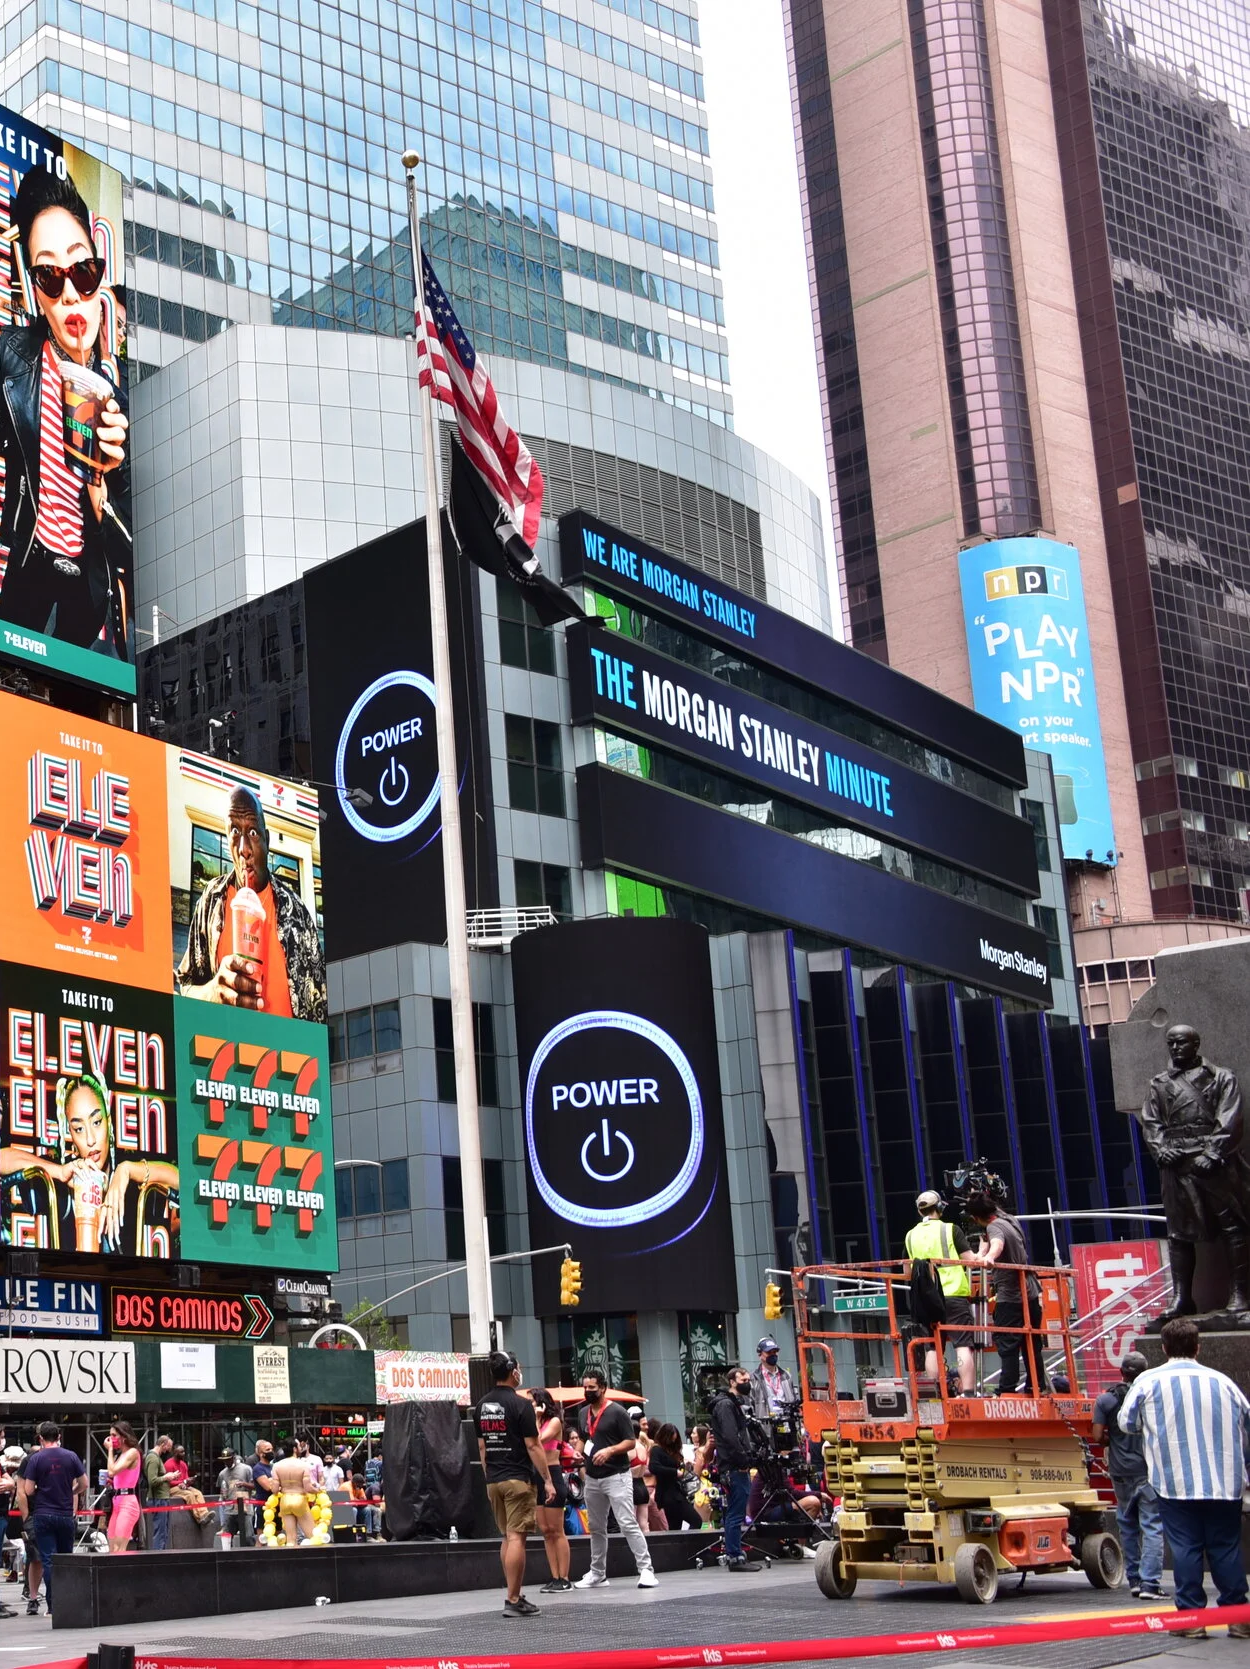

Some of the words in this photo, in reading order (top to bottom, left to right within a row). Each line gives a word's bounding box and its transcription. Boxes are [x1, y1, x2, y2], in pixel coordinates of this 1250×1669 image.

[21, 135, 41, 167] IT
[43, 148, 69, 182] TO
[582, 527, 609, 566] WE
[611, 546, 639, 582] ARE
[642, 558, 700, 613] MORGAN
[702, 588, 757, 639] STANLEY
[993, 570, 1061, 593] npr
[591, 647, 637, 710] THE
[642, 670, 735, 751] MORGAN
[738, 714, 820, 787] STANLEY
[825, 751, 894, 818] MINUTE
[1019, 716, 1039, 728] on
[1043, 715, 1074, 730] your
[59, 732, 81, 748] TAKE
[82, 736, 91, 751] IT
[91, 741, 104, 756] TO
[361, 717, 423, 757] POWER
[1043, 733, 1092, 748] speaker.
[979, 938, 1015, 971] Morgan
[1014, 950, 1047, 985] Stanley
[61, 988, 89, 1008] TAKE
[90, 993, 99, 1010] IT
[99, 996, 114, 1012] TO
[189, 1033, 236, 1129] 7
[234, 1041, 279, 1135] 7
[279, 1050, 320, 1142] 7
[551, 1077, 660, 1112] POWER
[193, 1133, 239, 1230] 7
[238, 1139, 282, 1237] 7
[281, 1146, 323, 1239] 7
[53, 1282, 97, 1312] FIN
[846, 1297, 856, 1309] W
[857, 1296, 866, 1308] 47
[867, 1295, 877, 1308] St
[56, 1315, 97, 1328] SUSHI
[115, 1294, 155, 1328] DOS
[160, 1298, 243, 1332] CAMINOS
[1095, 1252, 1148, 1368] tkts
[257, 1356, 286, 1367] EVEREST
[391, 1366, 414, 1389] DOS
[417, 1367, 469, 1389] CAMINOS
[984, 1399, 1039, 1420] DROBACH
[480, 1420, 507, 1431] FILMS
[859, 1425, 895, 1440] 1654
[946, 1465, 978, 1479] DROBACH
[979, 1467, 1007, 1480] RENTALS
[1037, 1535, 1050, 1548] JLG
[936, 1632, 957, 1648] tkts
[702, 1648, 723, 1663] tkts
